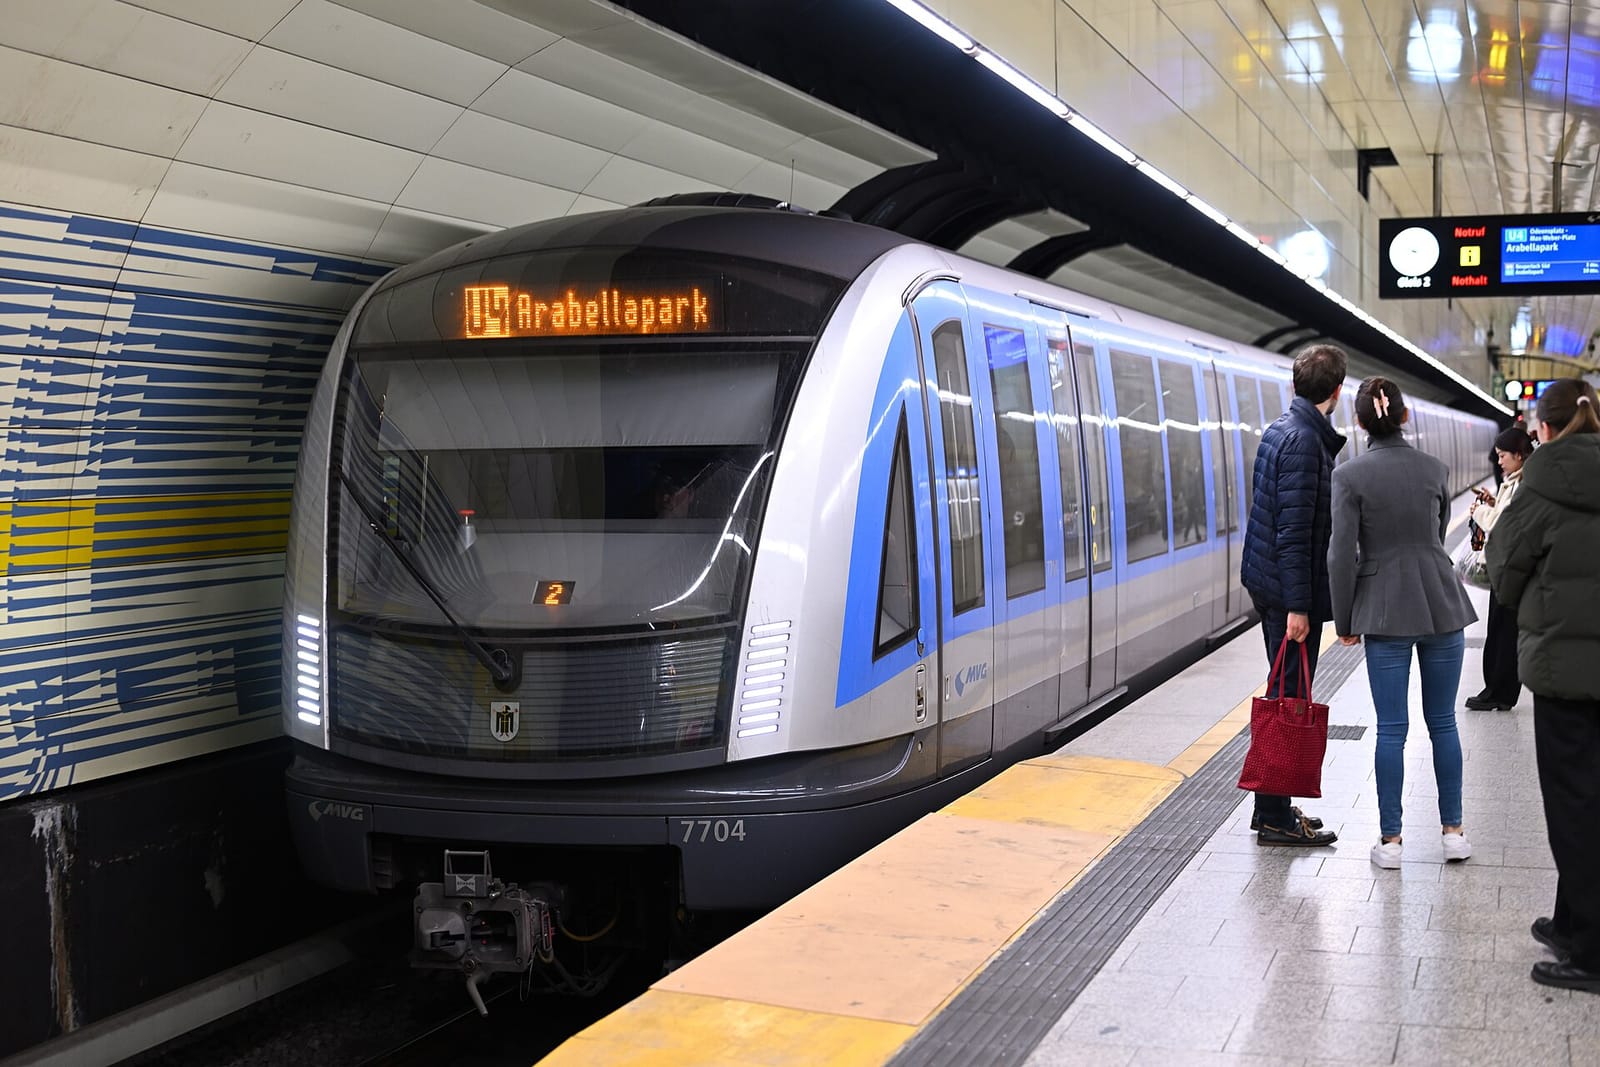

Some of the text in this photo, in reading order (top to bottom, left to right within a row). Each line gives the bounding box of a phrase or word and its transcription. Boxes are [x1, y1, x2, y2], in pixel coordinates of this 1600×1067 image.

[1454, 226, 1486, 238] Notruf
[1508, 230, 1523, 240] U4
[1506, 242, 1559, 254] Arabellapark
[1452, 275, 1488, 286] Nothalt
[466, 287, 708, 338] U4 Arabellapark
[545, 583, 563, 606] 2
[966, 663, 987, 684] MVG
[322, 802, 364, 821] MVG
[680, 819, 747, 843] 7704
